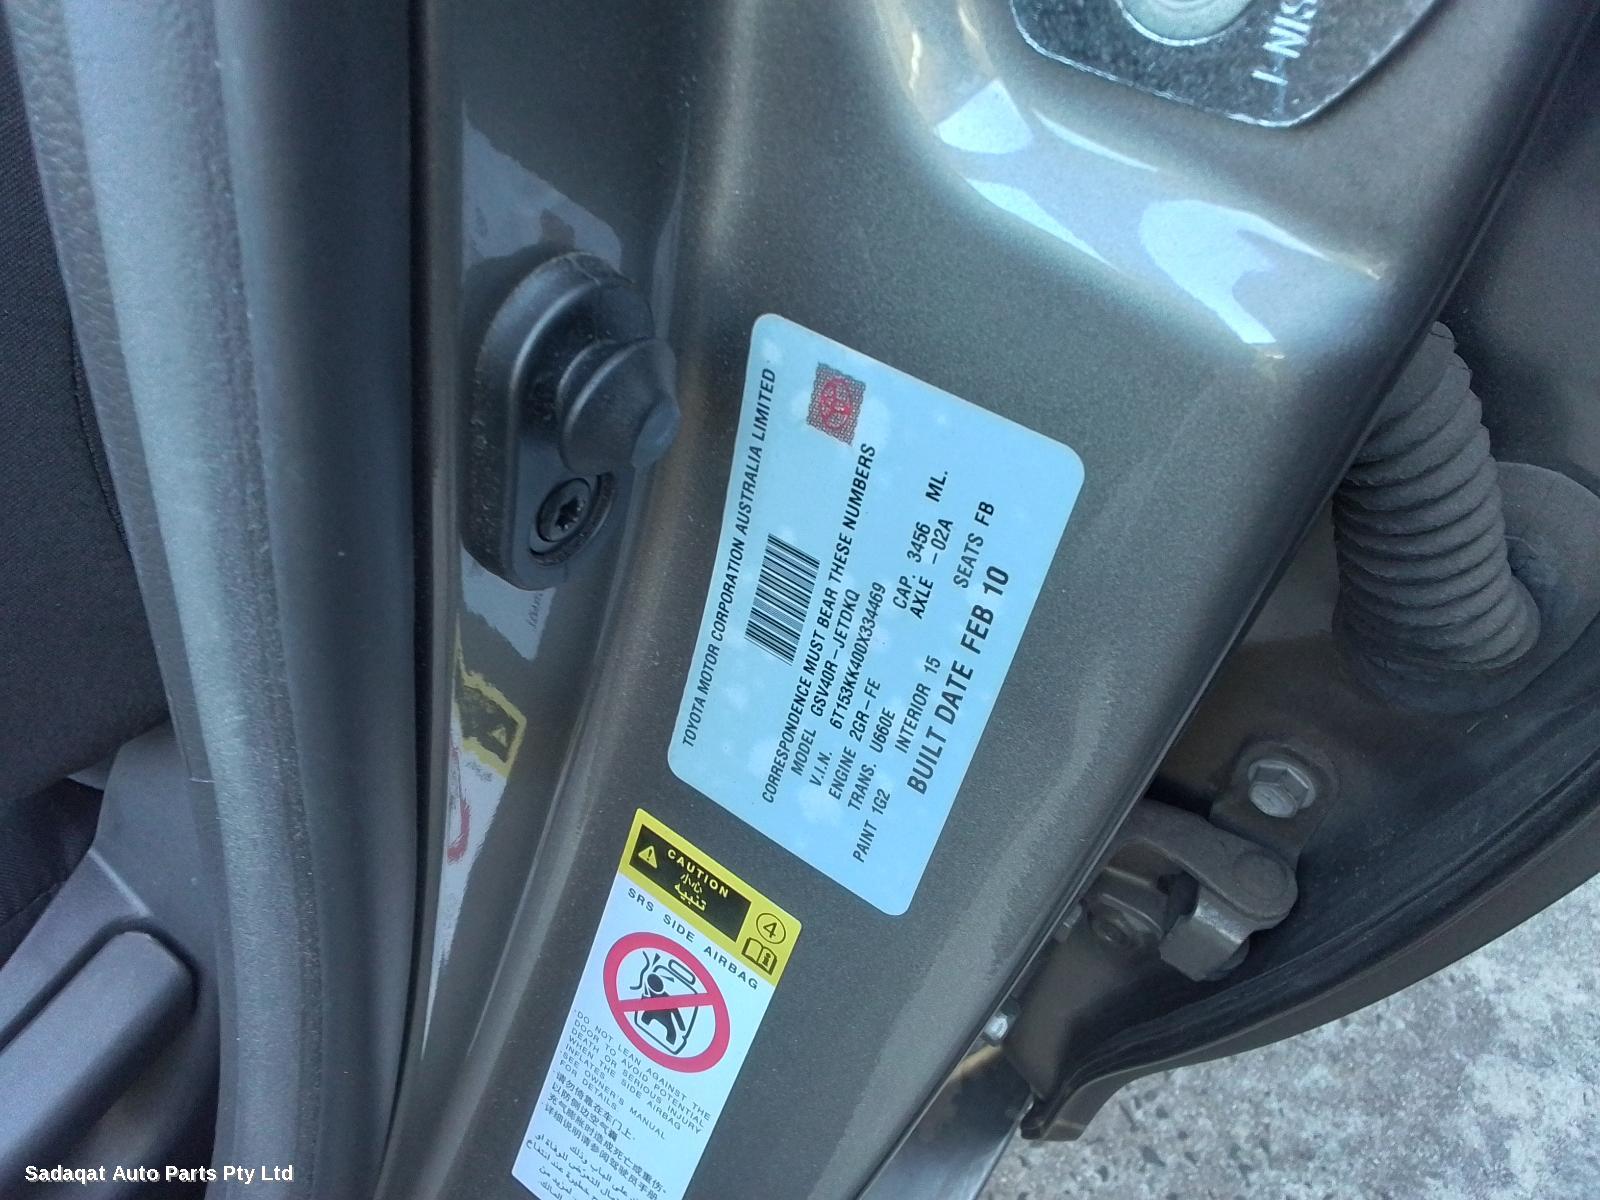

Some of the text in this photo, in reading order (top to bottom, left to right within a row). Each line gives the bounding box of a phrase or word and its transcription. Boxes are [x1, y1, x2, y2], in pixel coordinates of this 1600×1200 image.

[682, 369, 775, 747] TOYOTA MOTOR CORPORATION AUSTRALIA LIMITED
[762, 444, 875, 803] CORRESPONDENCE MUST BEAR THESE NUMBERS
[829, 746, 856, 800] ENGINE
[893, 575, 915, 609] CAP.
[907, 522, 930, 563] 3456
[926, 472, 947, 502] ML.
[809, 582, 885, 786] V.I.N. 6T153KK400X334469
[848, 764, 876, 810] TRANS.
[869, 707, 895, 753] U660E
[910, 576, 933, 619] AXLE
[853, 502, 994, 863] PAINT 1G2 INTERIOR 15 SEATS FB
[907, 566, 1008, 794] BUILT DATE FEB 10
[791, 729, 816, 776] MODEL
[668, 849, 729, 898] CAUTION
[628, 887, 758, 990] SRS SIDE AIRBAG
[559, 1059, 577, 1077] FOR
[568, 1035, 682, 1130] WHEN THE SIDE AIRBAG
[571, 1027, 701, 1135] DEATH OR SERIOUS INJURY
[573, 1019, 705, 1127] DOOR TO AVOID POTENTIAL
[594, 1025, 613, 1042] NOT
[617, 1044, 641, 1066] LEAN
[646, 1067, 687, 1101] AGAINST
[690, 1101, 711, 1120] THE
[628, 1107, 666, 1139] MANUAL
